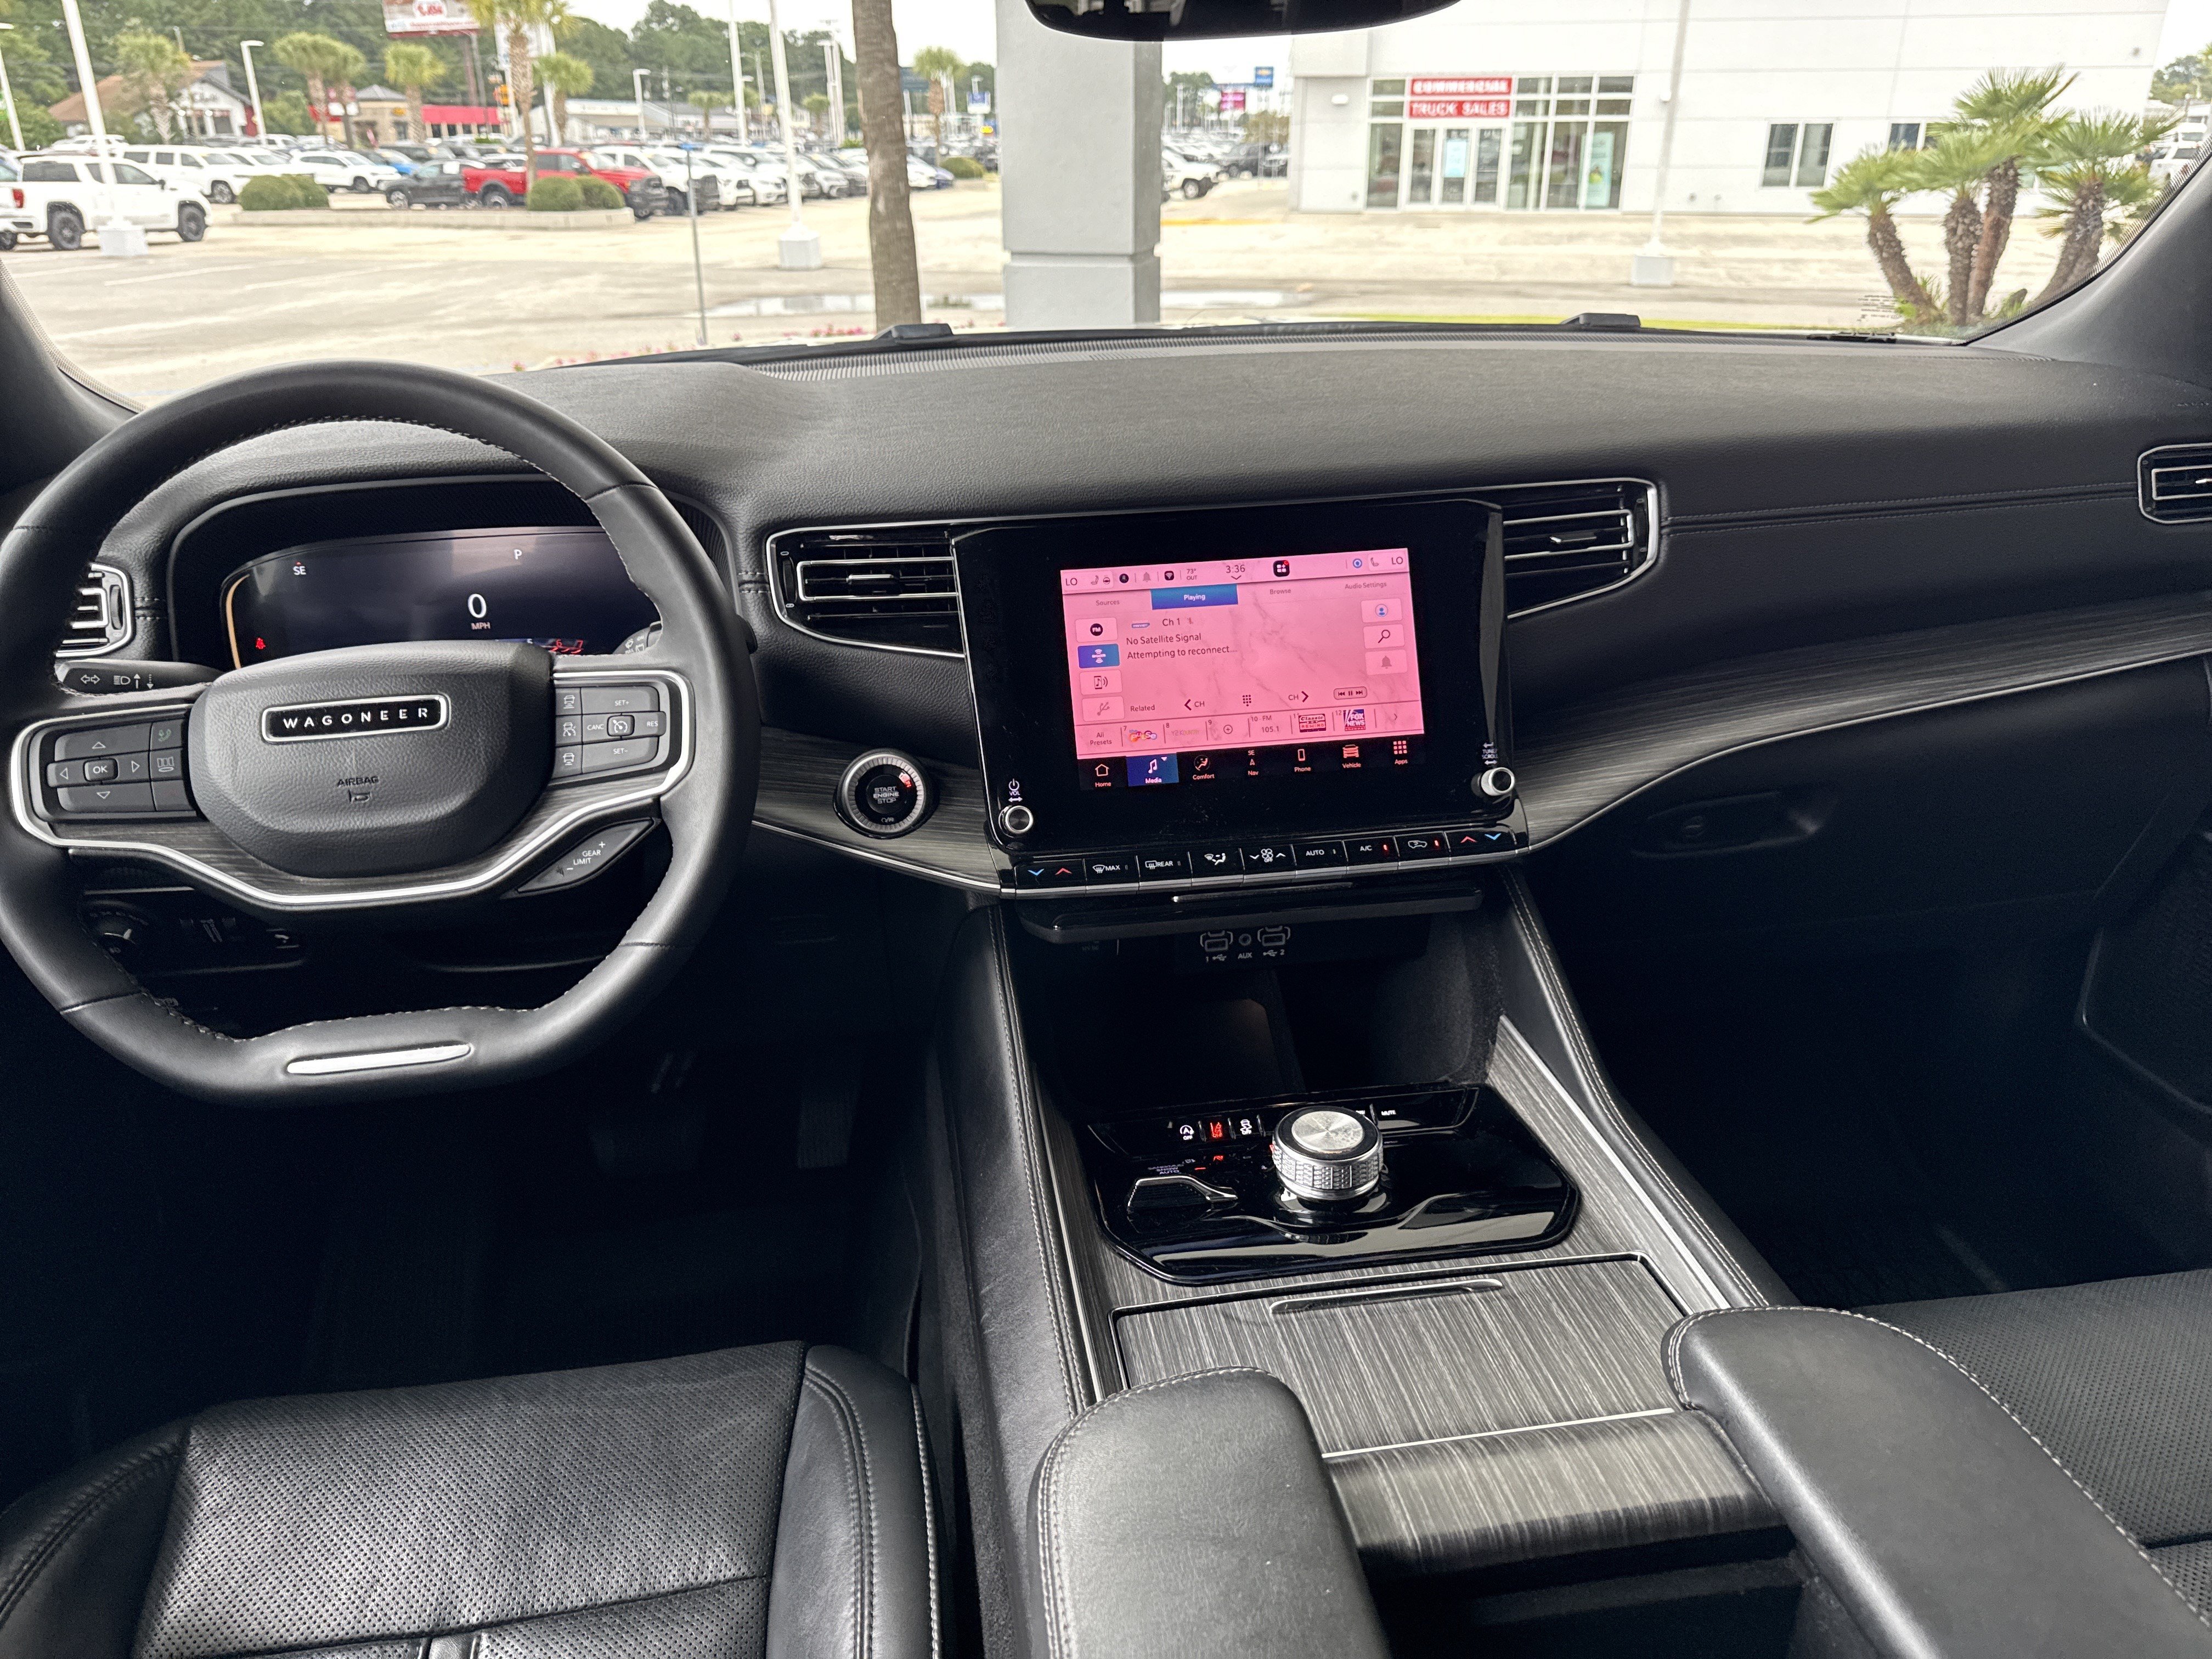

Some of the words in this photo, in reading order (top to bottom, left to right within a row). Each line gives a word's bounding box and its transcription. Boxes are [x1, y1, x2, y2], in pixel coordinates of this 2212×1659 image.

[1412, 102, 1458, 116] TRUCK
[1463, 101, 1506, 116] SALES
[514, 549, 522, 560] P
[1391, 556, 1403, 566] LO
[293, 566, 306, 575] SE
[1226, 565, 1245, 574] 3:36
[1065, 577, 1078, 586] LO
[467, 594, 487, 619] 0
[471, 622, 490, 630] MPH
[1162, 618, 1174, 627] Ch
[1141, 634, 1173, 645] Satellite
[1176, 633, 1201, 643] Signal
[1127, 648, 1175, 660] Attempting
[283, 707, 428, 729] WAGONEER
[93, 765, 108, 774] OK
[337, 775, 379, 787] AIRBAG
